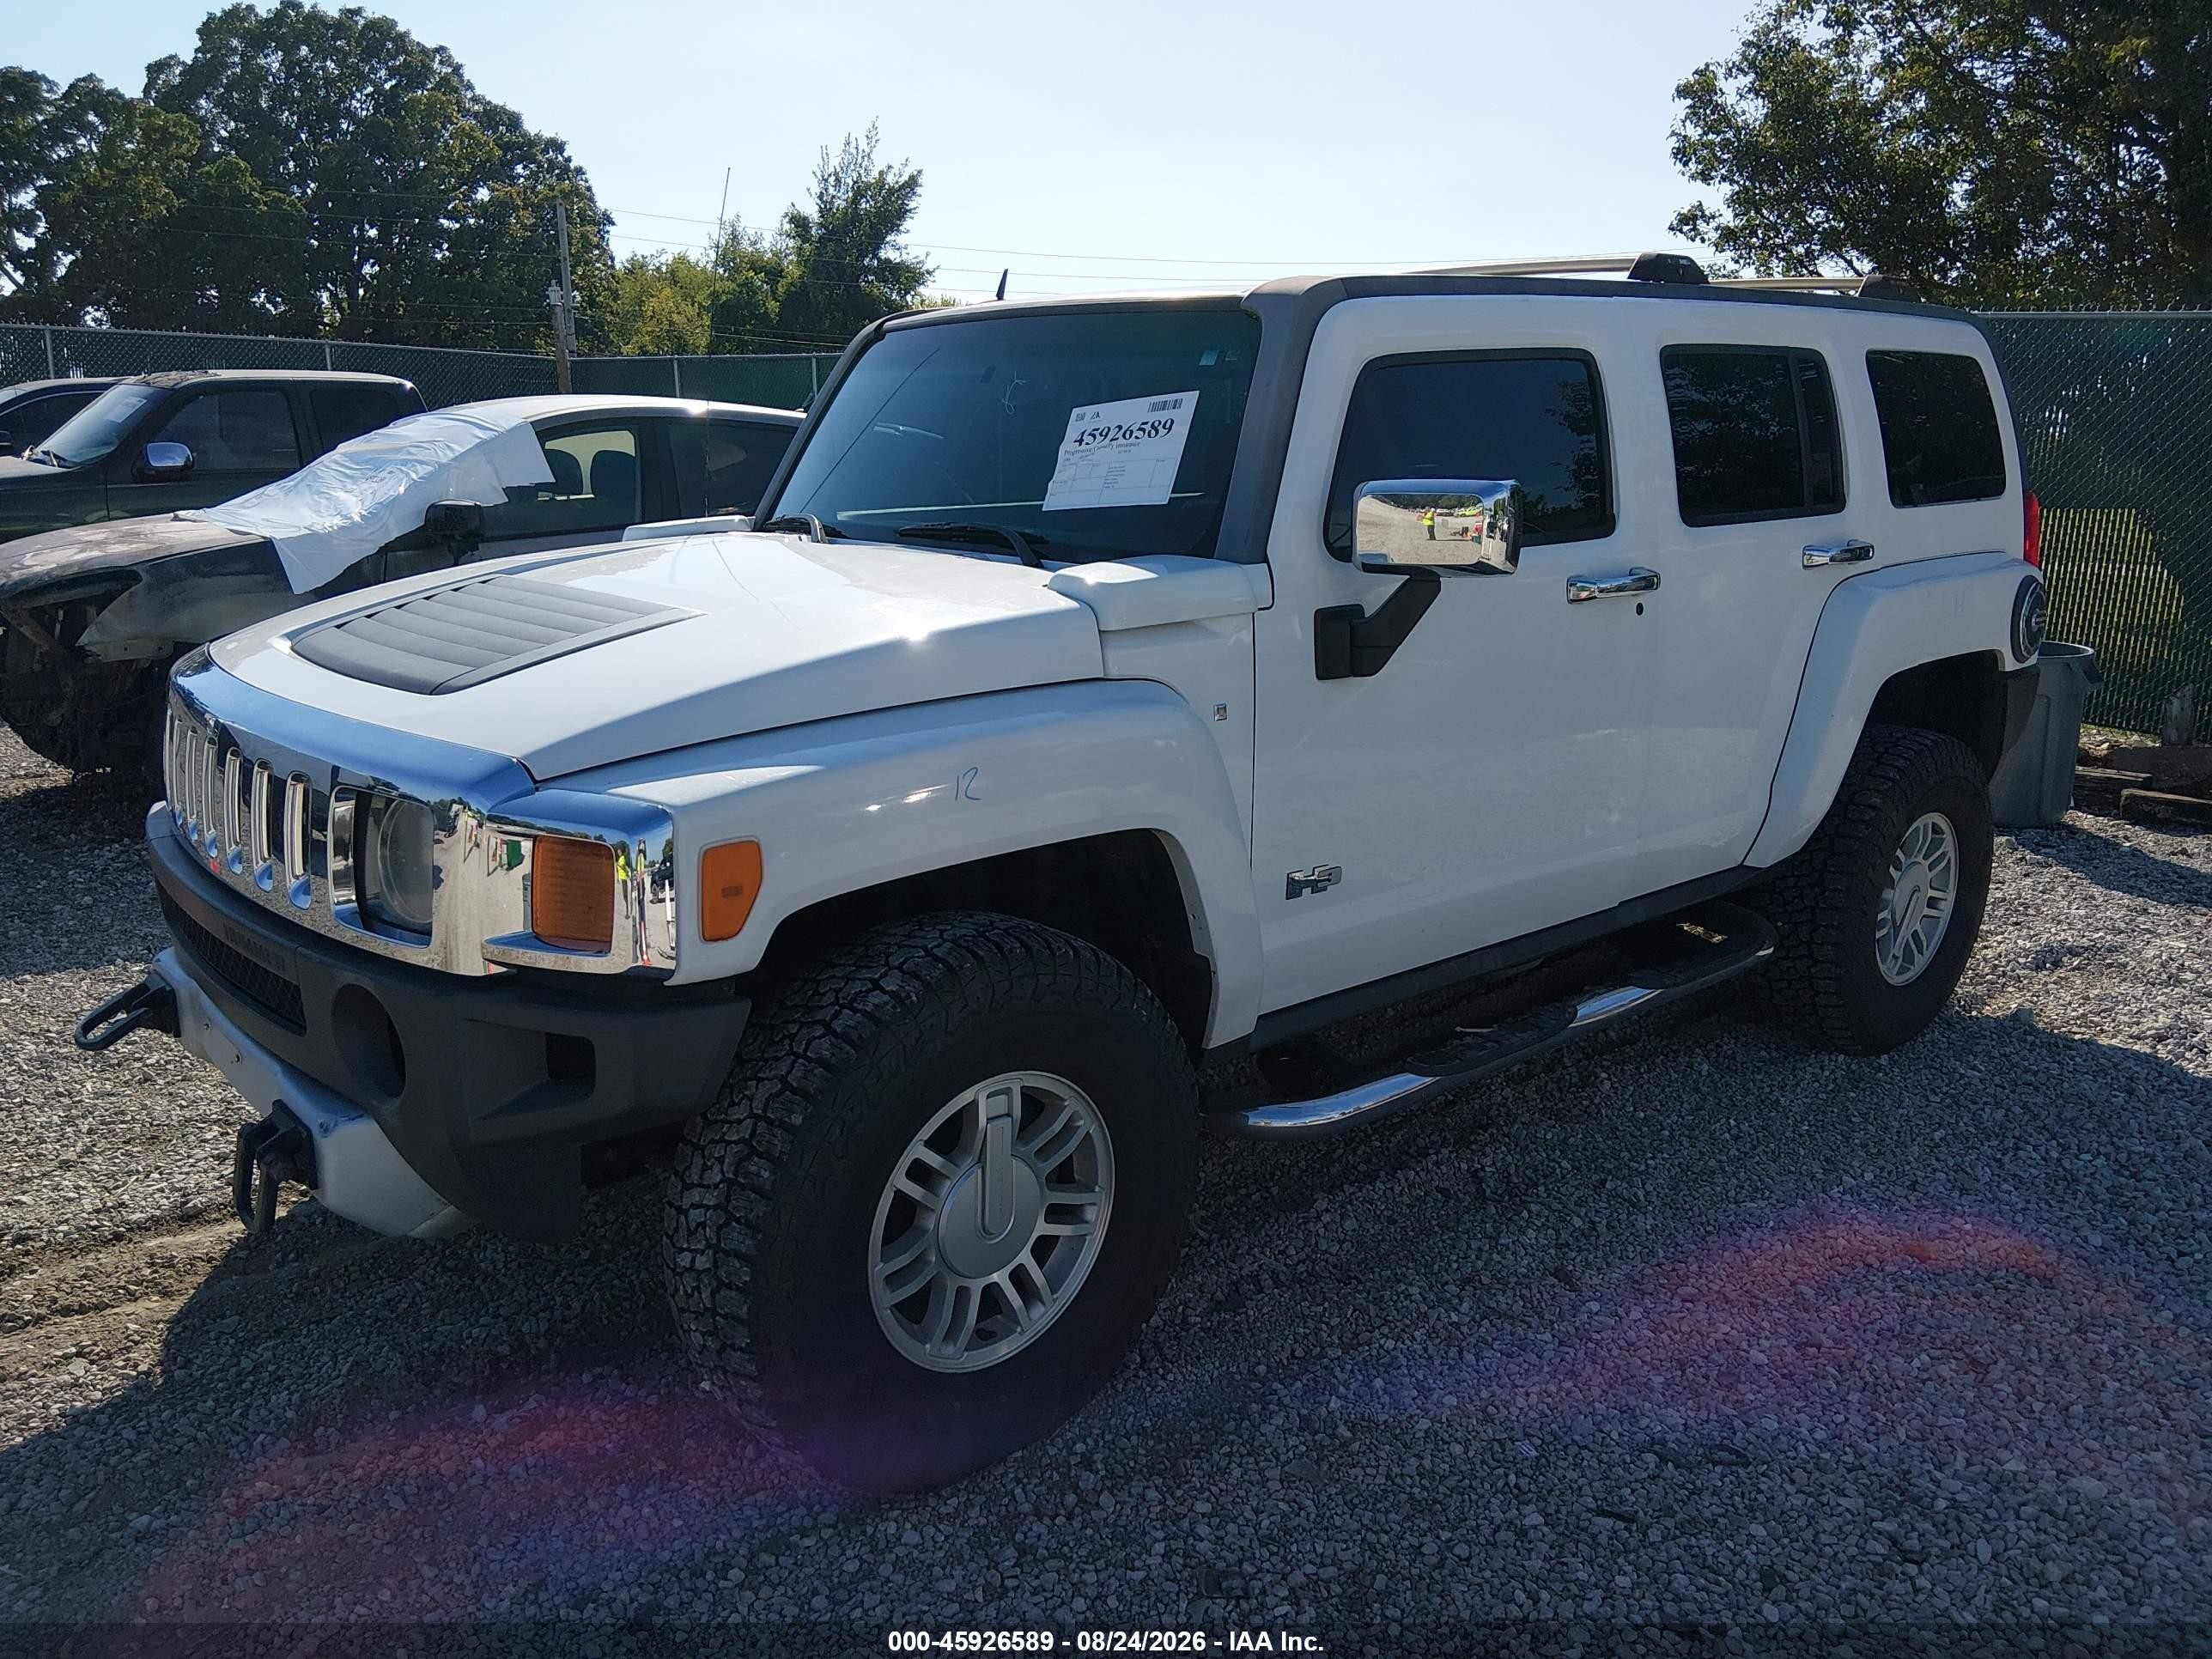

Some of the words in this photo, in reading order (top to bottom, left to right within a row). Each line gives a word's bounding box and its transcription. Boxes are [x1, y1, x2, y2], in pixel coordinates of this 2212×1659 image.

[1073, 417, 1175, 447] 45926589
[955, 767, 982, 801] 12
[1285, 864, 1342, 900] H3
